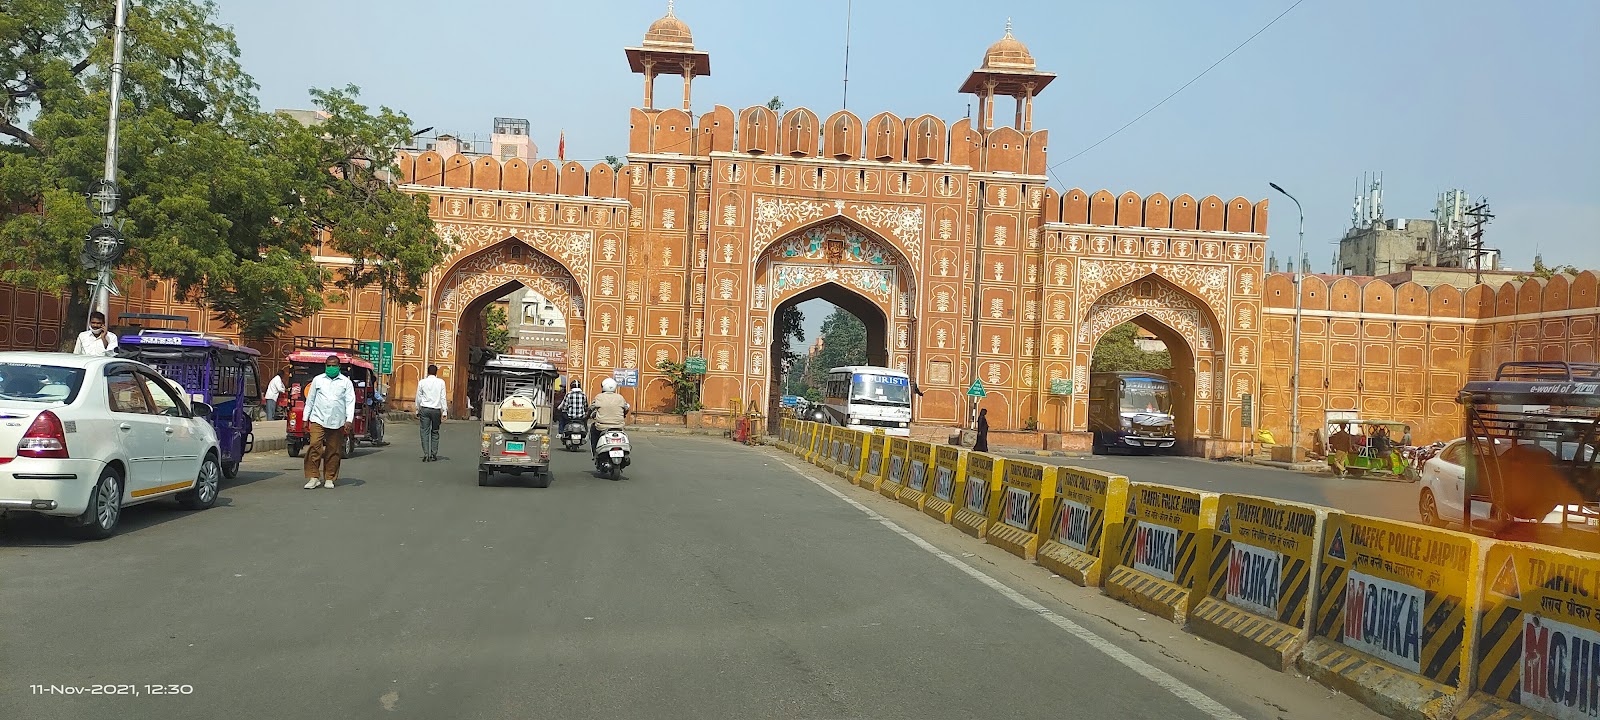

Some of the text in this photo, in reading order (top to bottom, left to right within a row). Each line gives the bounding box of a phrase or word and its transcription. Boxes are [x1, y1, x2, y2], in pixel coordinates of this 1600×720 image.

[860, 375, 905, 385] TOURIST
[1530, 384, 1561, 393] e-world
[1561, 384, 1571, 393] of
[1141, 489, 1161, 507] TRAFFIC
[1162, 493, 1180, 511] POLICE
[1181, 496, 1200, 516] JAIPUR
[1236, 502, 1316, 537] TRAFFIC POLICE JAIPUR
[1136, 526, 1174, 575] MOJIKA
[1351, 523, 1469, 571] TRAFFIC POLICE JAIPUR
[1228, 545, 1279, 611] MOJIKA
[1529, 558, 1589, 597] TRAFFIC
[1345, 578, 1420, 663] MOJIKA
